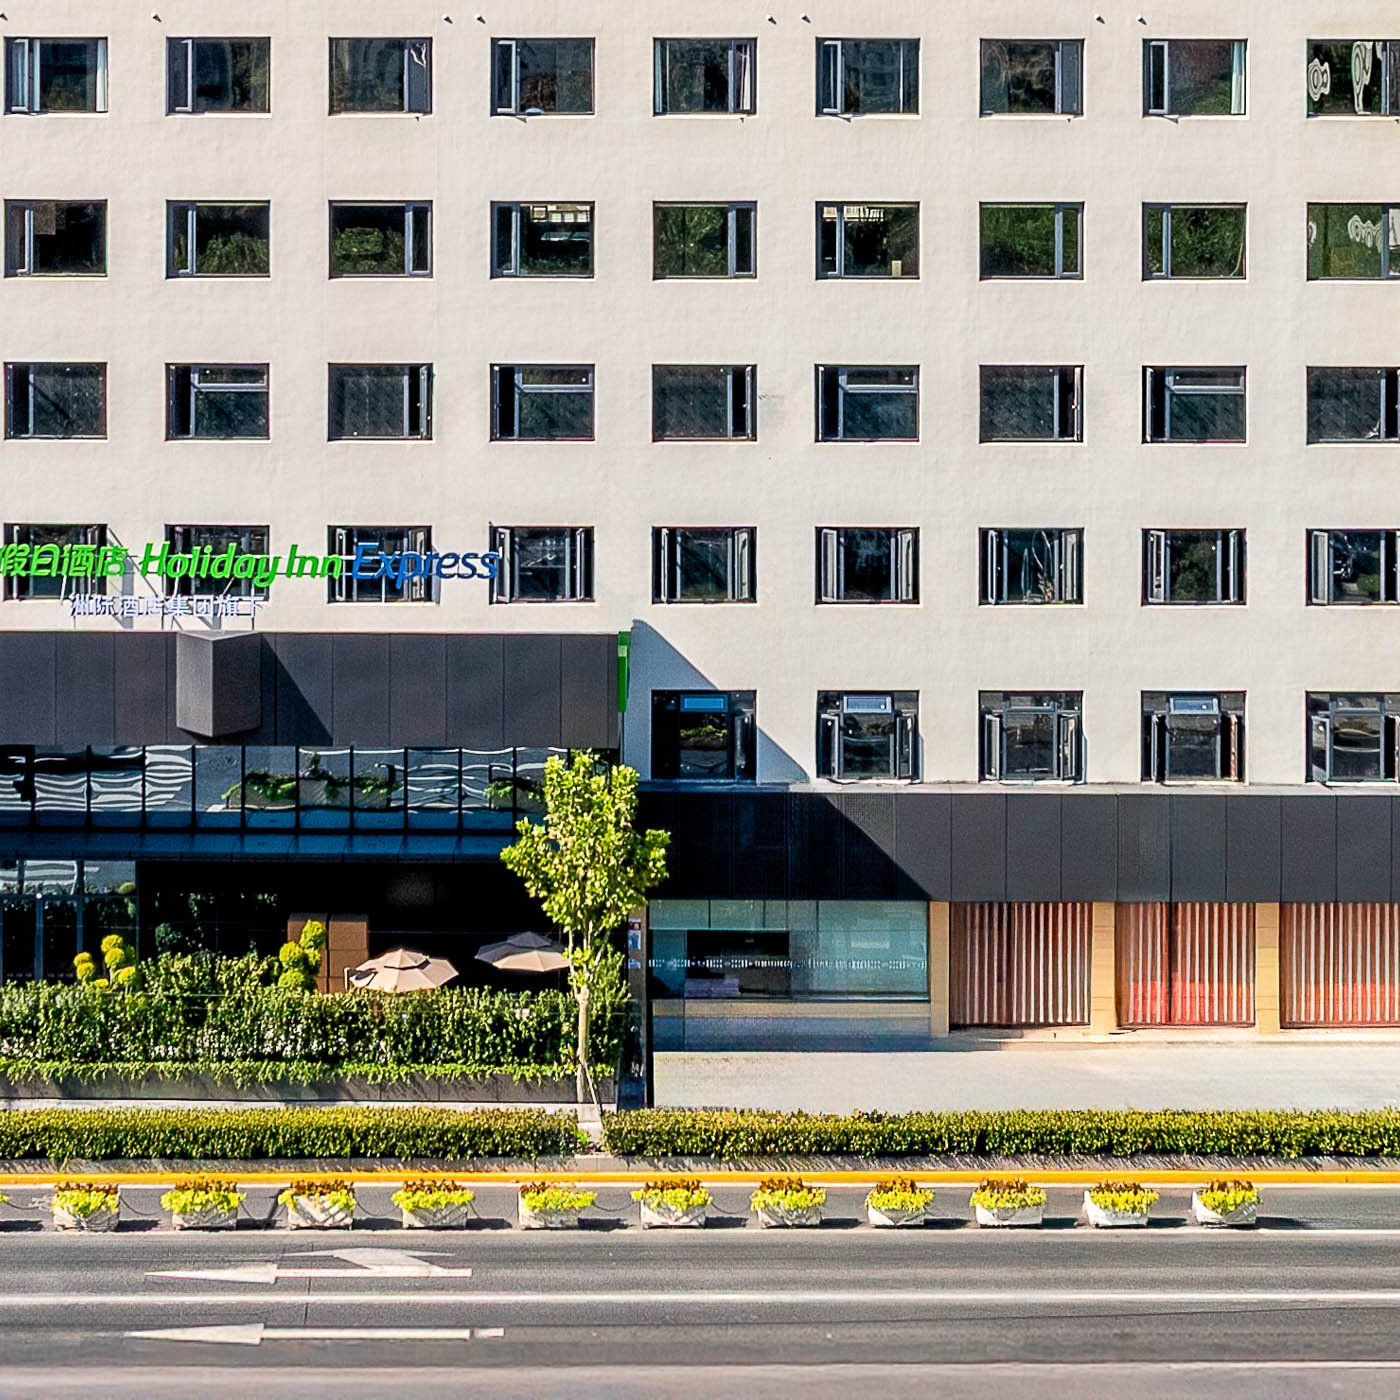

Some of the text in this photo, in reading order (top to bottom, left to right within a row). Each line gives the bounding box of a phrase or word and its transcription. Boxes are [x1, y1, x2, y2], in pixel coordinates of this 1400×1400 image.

[140, 540, 281, 588] Holiday
[287, 543, 343, 579] Inn
[351, 541, 499, 589] Express
[69, 593, 266, 618] 洲际酒店集团旗下
